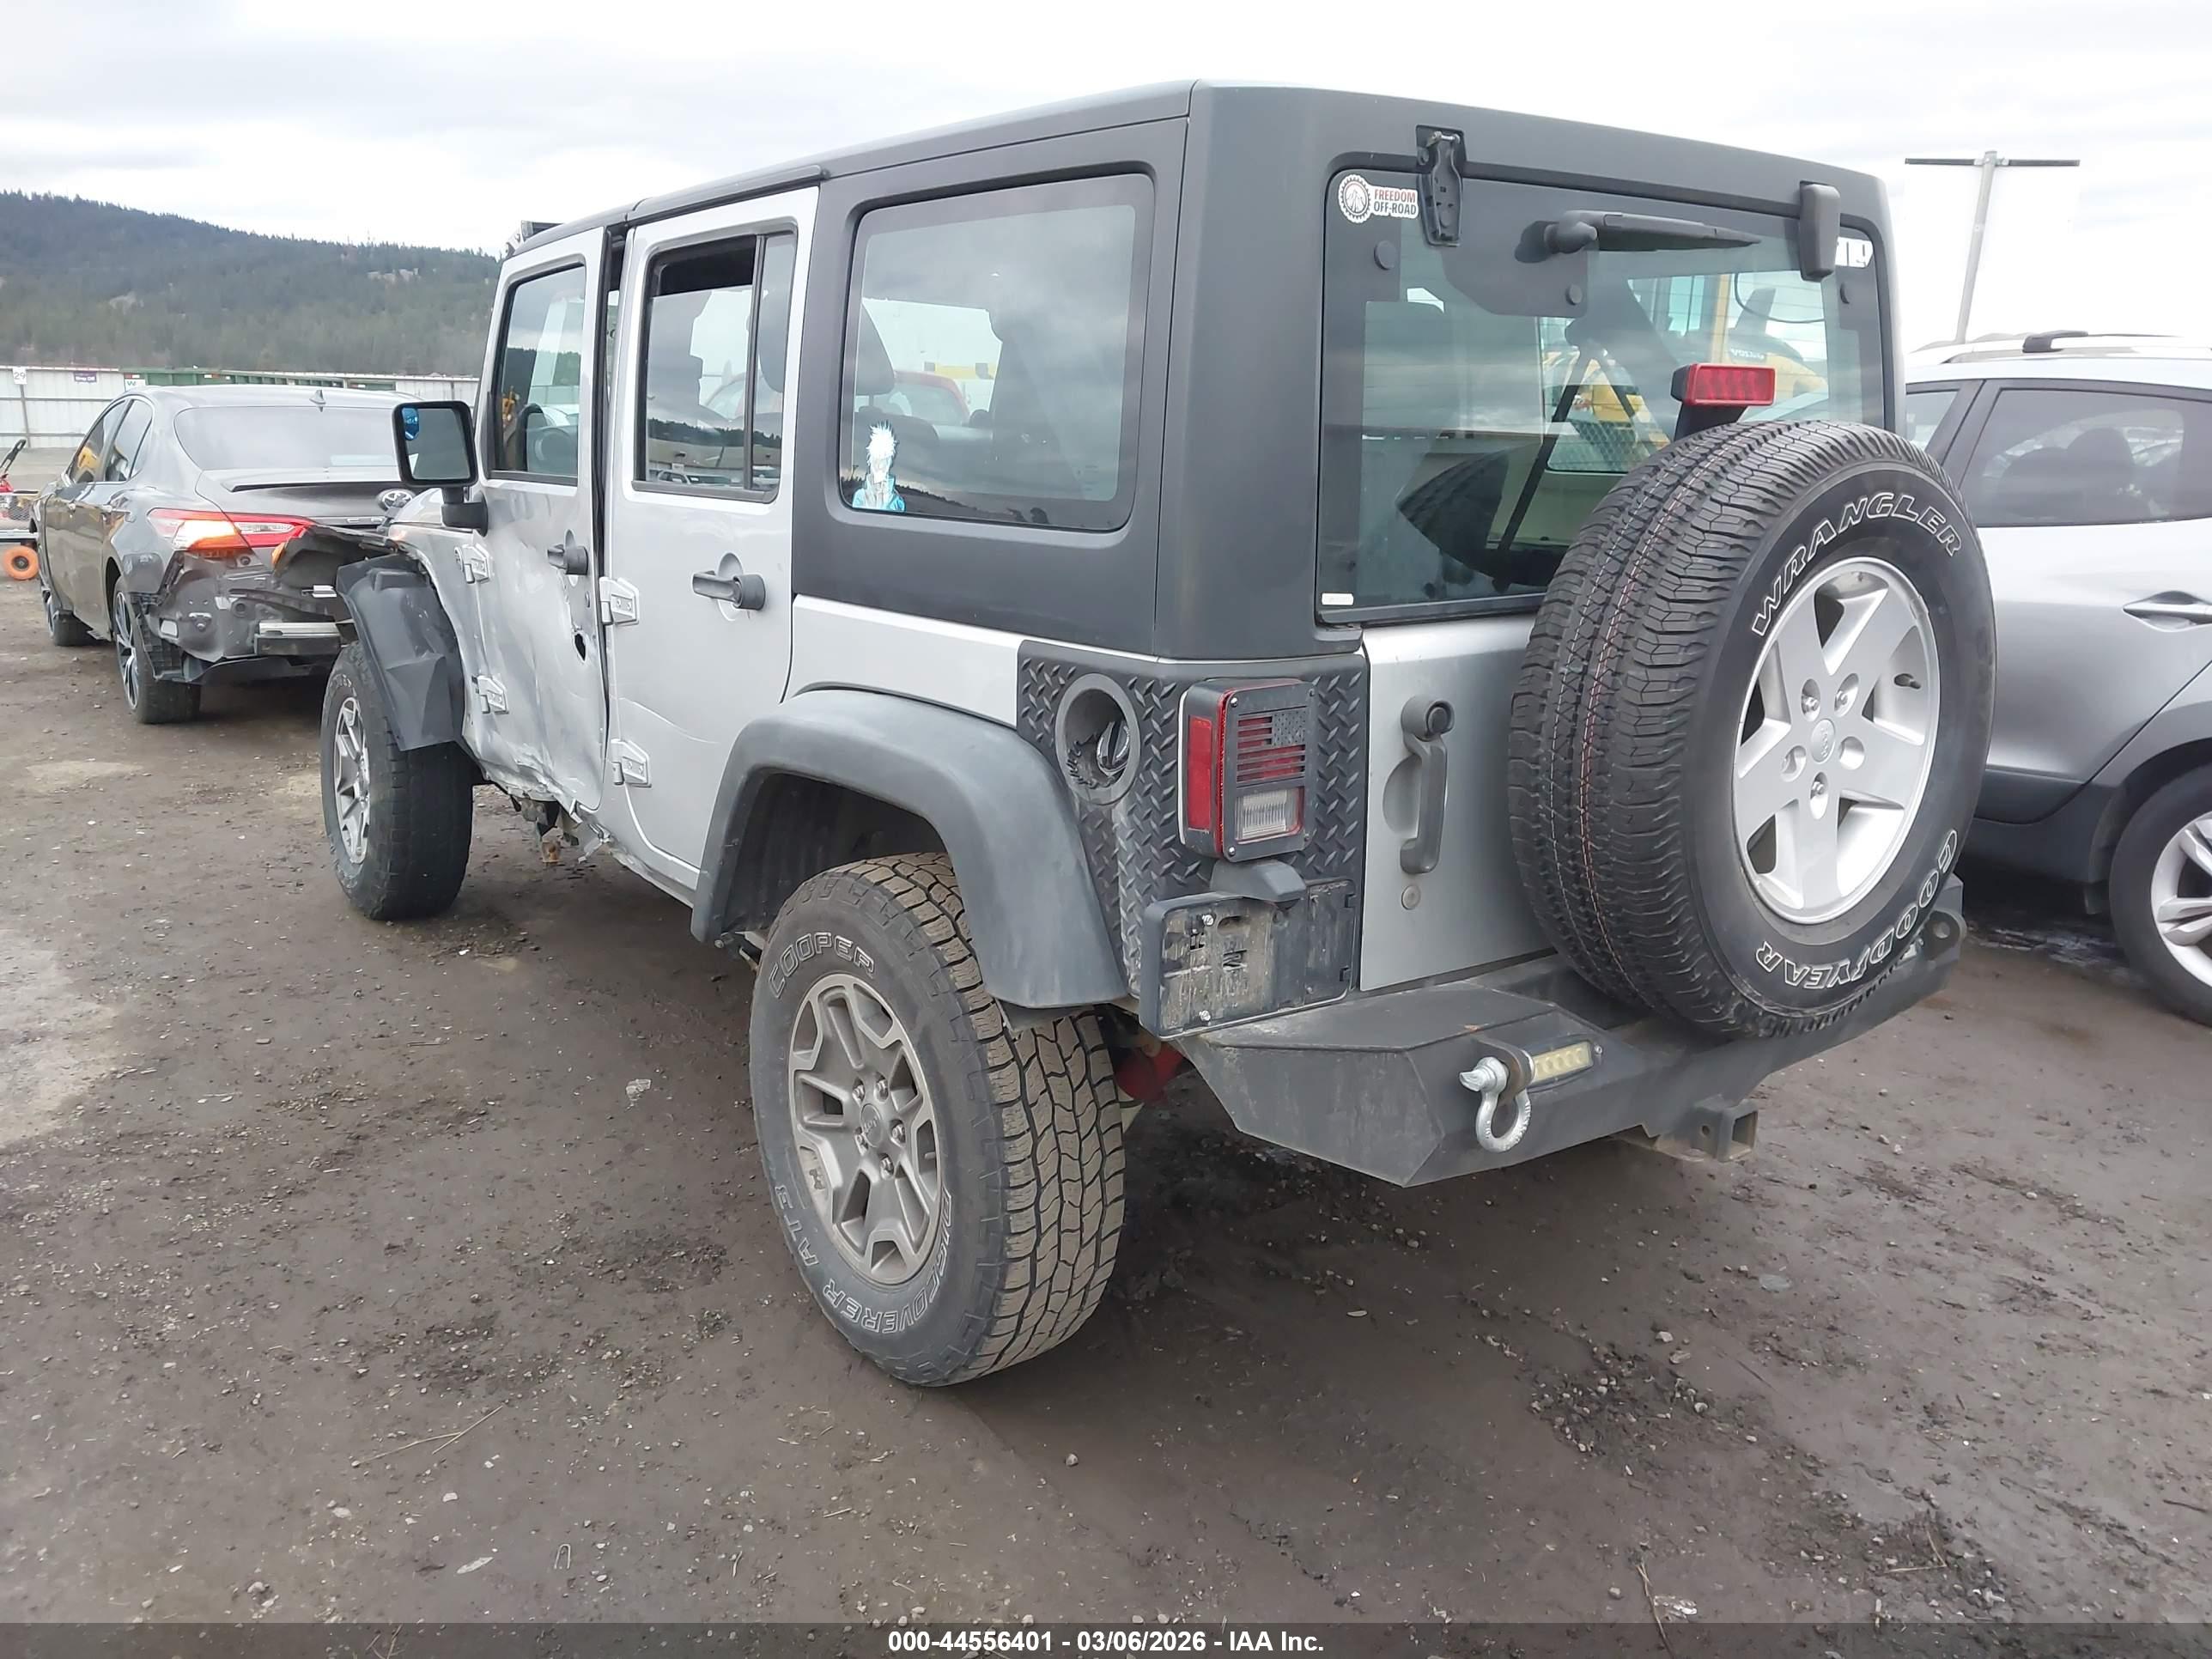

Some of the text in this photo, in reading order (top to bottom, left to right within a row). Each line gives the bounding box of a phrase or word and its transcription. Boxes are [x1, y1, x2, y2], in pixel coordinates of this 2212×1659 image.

[1373, 200, 1417, 216] OFF-ROAD
[1374, 189, 1416, 204] FREEDOM
[14, 371, 26, 380] 29
[1752, 492, 1961, 635] WRANGLER
[1756, 830, 1958, 988] GOODYEAR
[769, 932, 875, 999] COOPER
[823, 1187, 951, 1333] DISCOVERER
